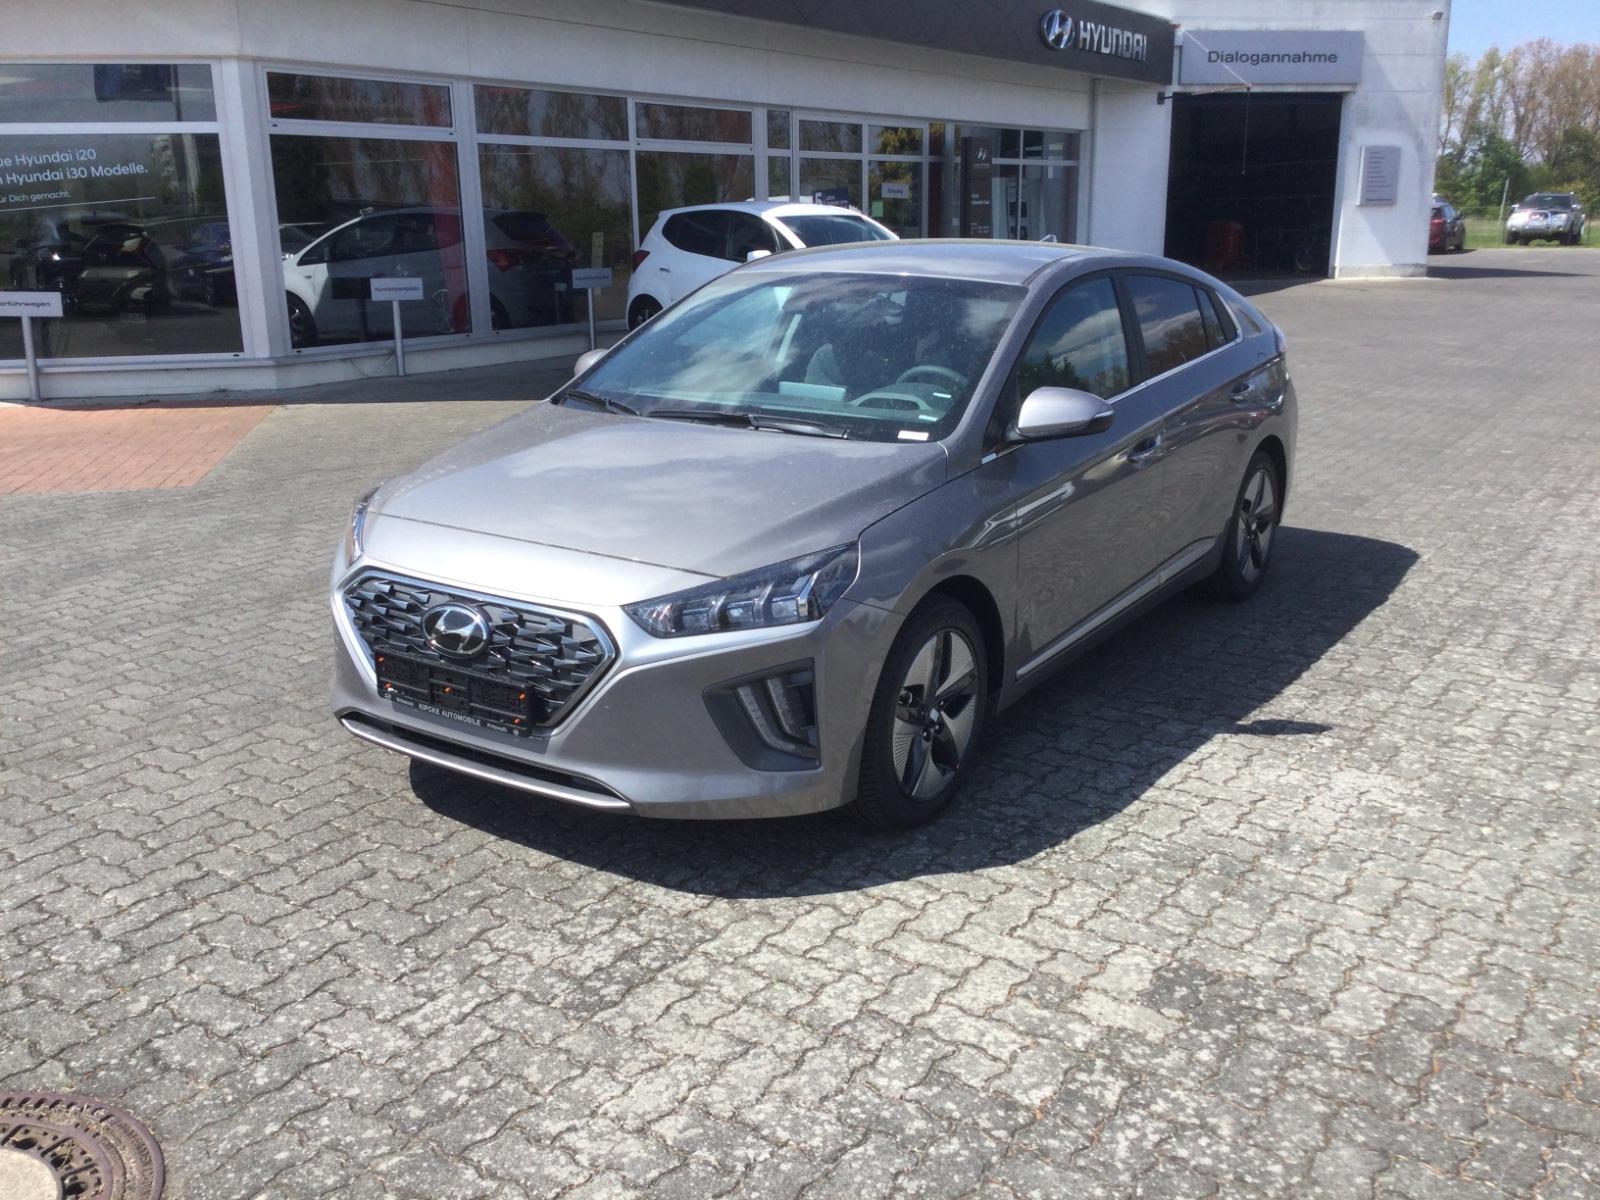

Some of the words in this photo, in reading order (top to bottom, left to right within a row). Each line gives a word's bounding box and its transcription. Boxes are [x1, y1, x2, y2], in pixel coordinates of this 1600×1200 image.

[1078, 20, 1147, 61] HYUNDAI
[1207, 50, 1338, 65] Dialogannahme
[15, 151, 73, 167] Hyundai
[75, 149, 96, 161] i20
[7, 169, 64, 186] Hyundai
[66, 168, 87, 180] i30
[91, 163, 148, 178] Modelle.
[441, 710, 480, 727] AUTOMOBILE
